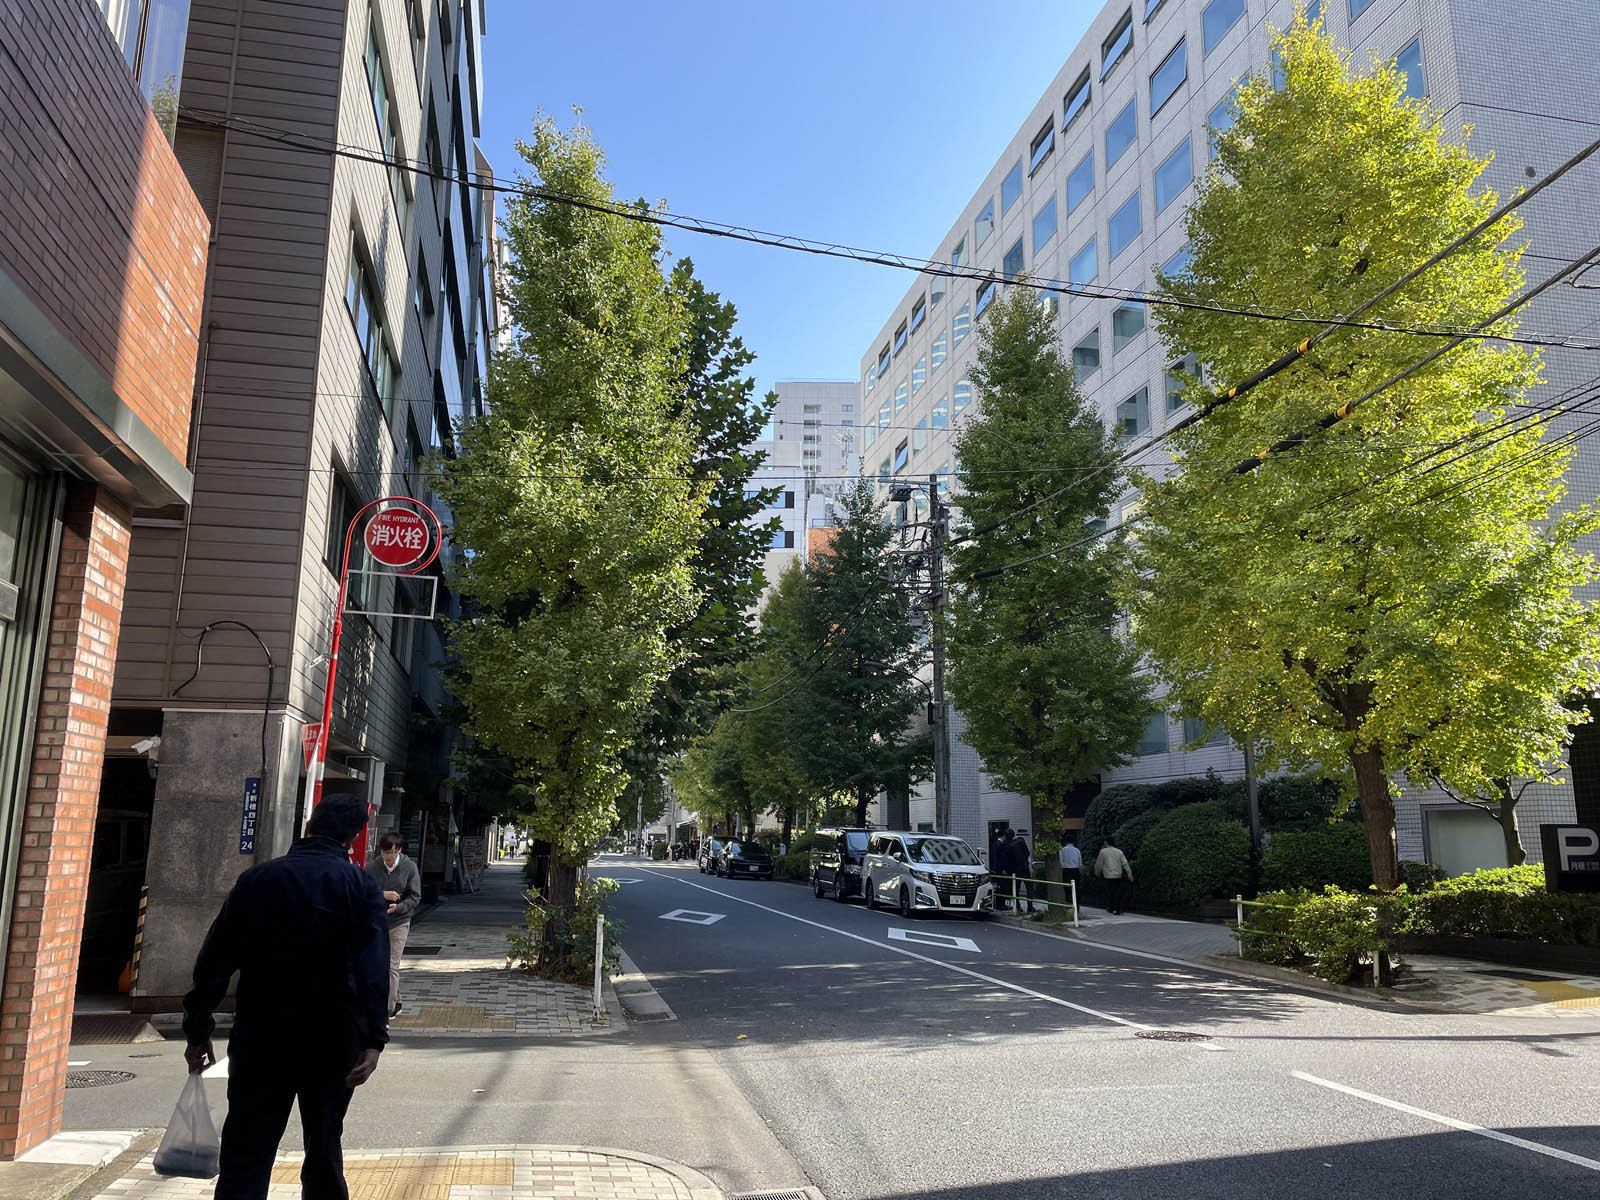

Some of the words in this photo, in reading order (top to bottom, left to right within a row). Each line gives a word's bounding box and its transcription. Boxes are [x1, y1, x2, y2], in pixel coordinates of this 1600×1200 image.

[392, 515, 419, 523] HYDRANT
[371, 524, 423, 549] 消火栓
[247, 794, 258, 836] 新橋四丁目
[241, 841, 253, 850] 24
[1557, 827, 1600, 872] P
